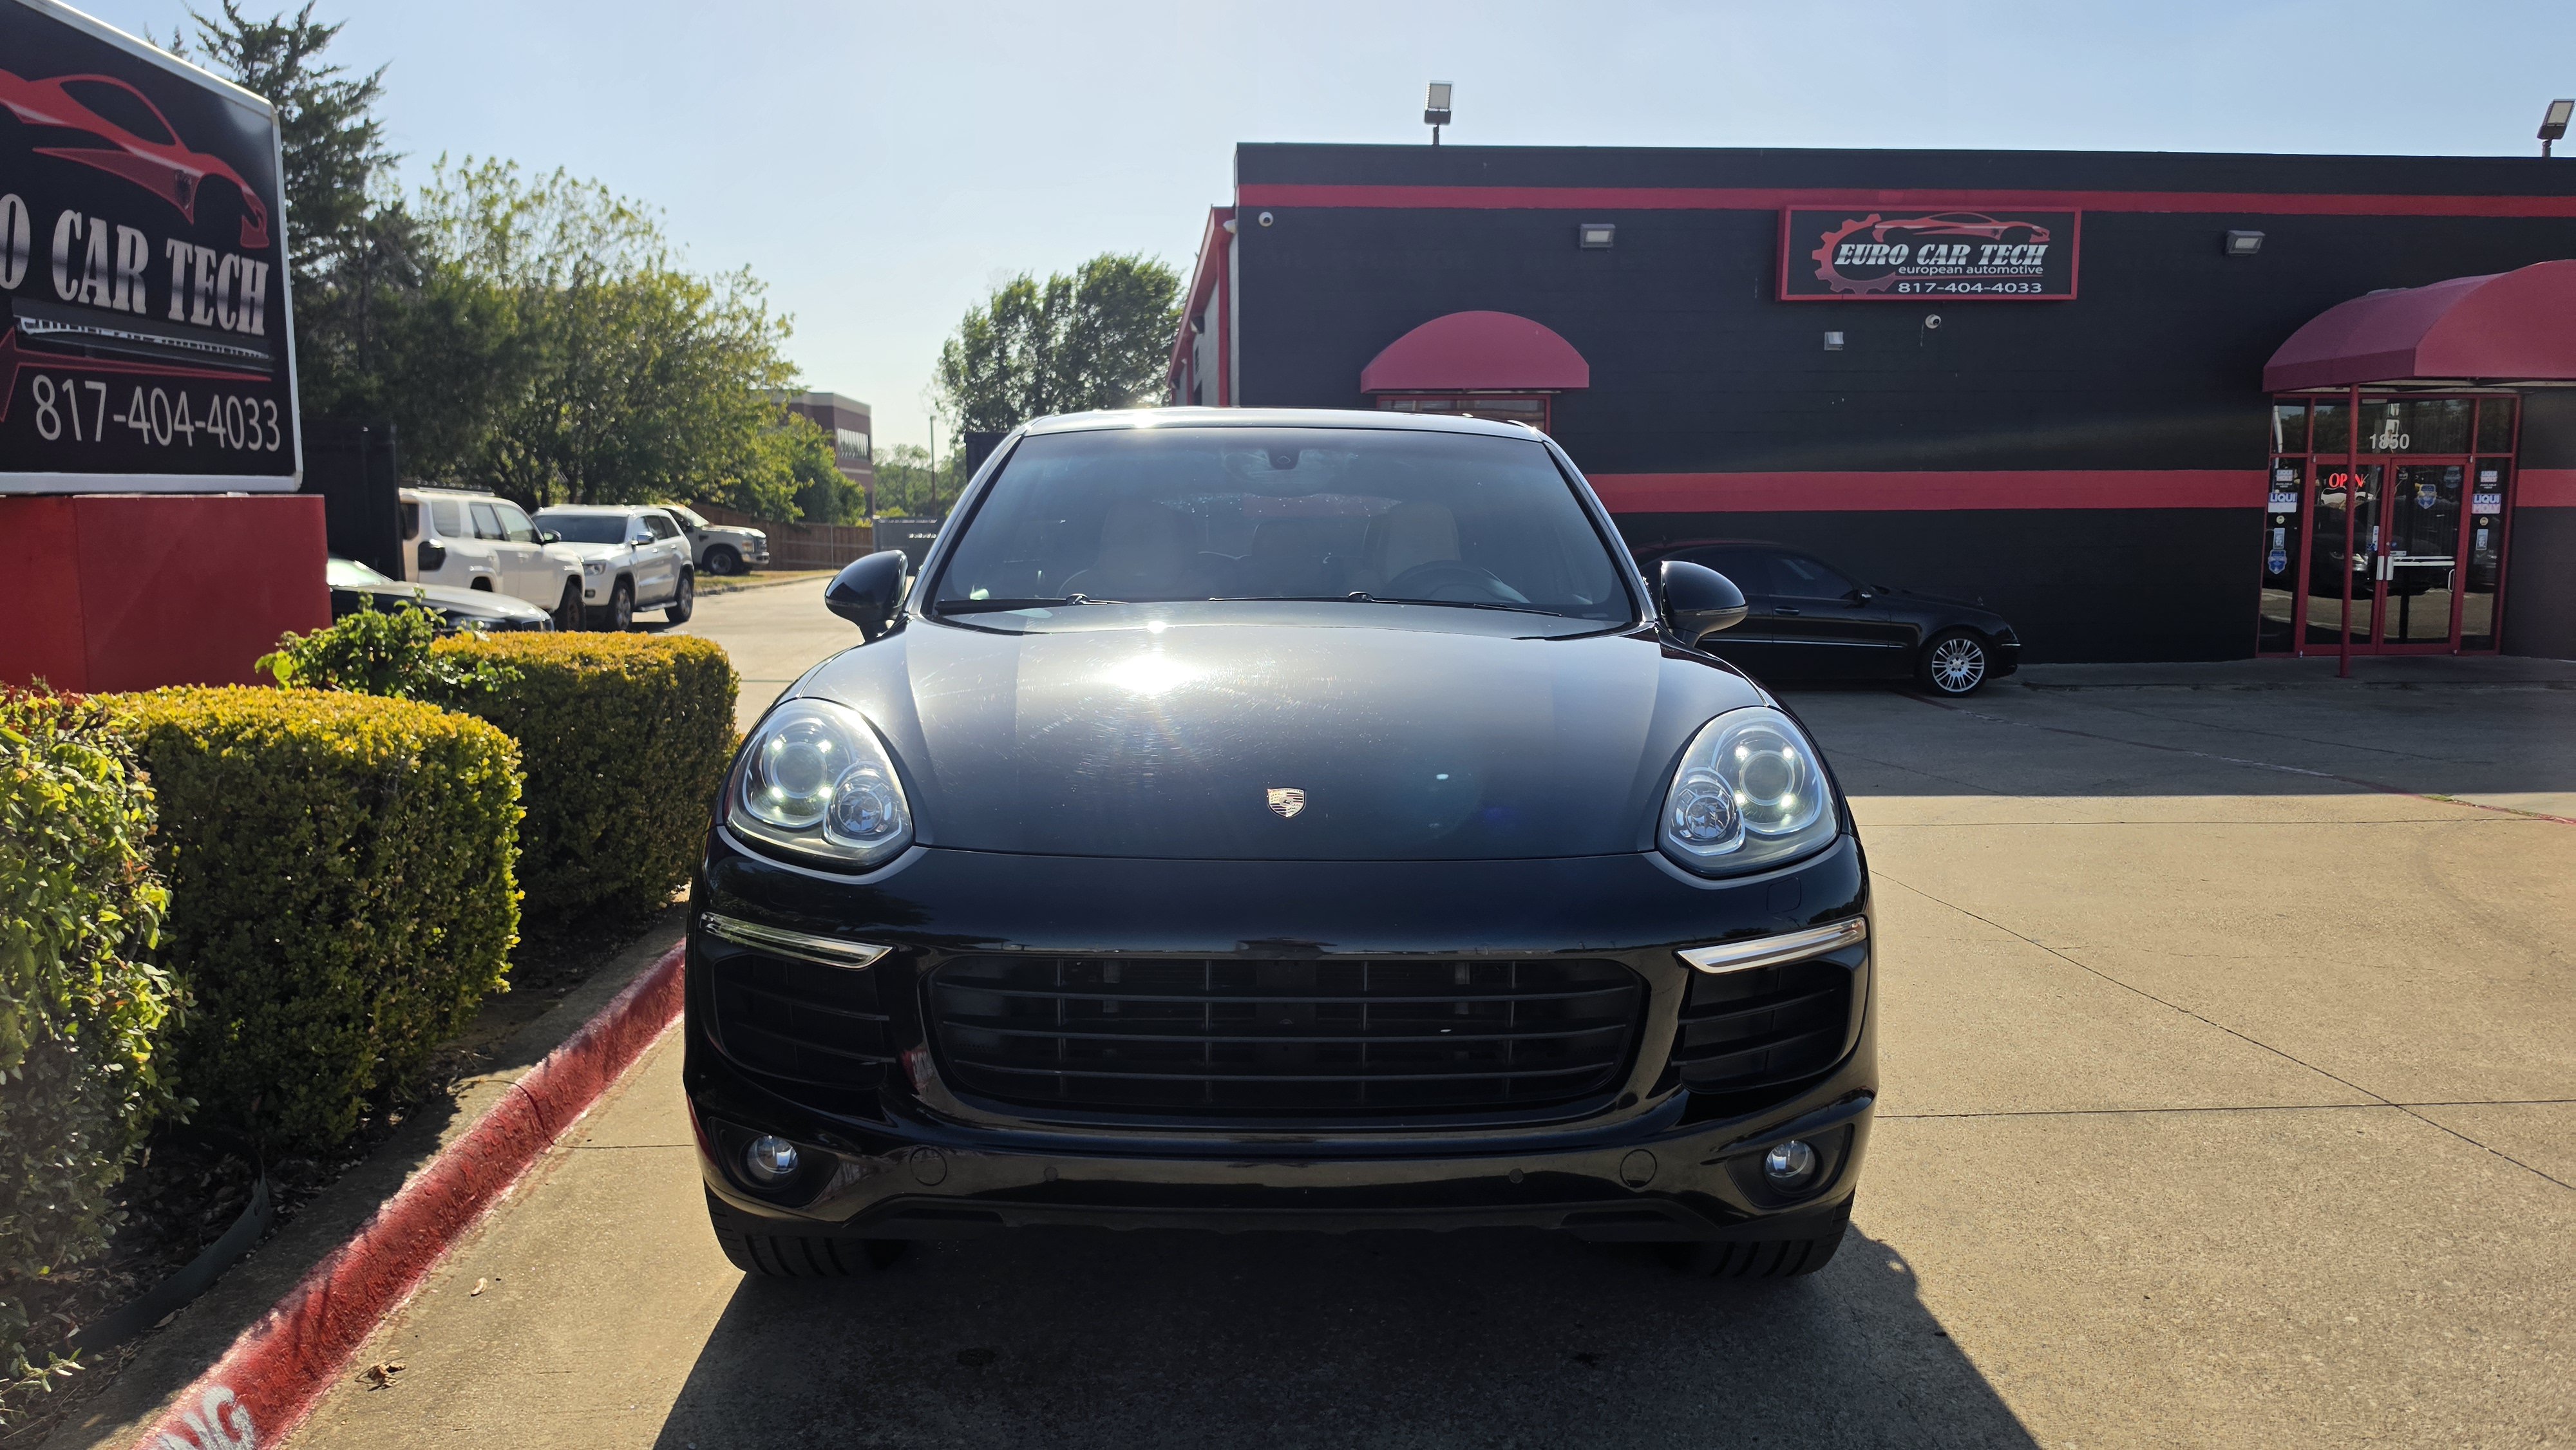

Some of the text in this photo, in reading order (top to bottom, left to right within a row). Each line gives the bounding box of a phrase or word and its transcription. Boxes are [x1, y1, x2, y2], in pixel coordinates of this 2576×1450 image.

[1834, 243, 2049, 266] EURO CAR TECH
[52, 209, 149, 315] CAR
[166, 238, 269, 335] TECH
[1899, 265, 2043, 276] european automotive
[1898, 282, 2042, 294] 817-404-4033
[33, 375, 280, 451] 817-404-4033
[2369, 433, 2410, 449] 1850
[2329, 473, 2365, 487] OPN
[2270, 493, 2296, 502] LIQUI
[2474, 494, 2499, 503] LIQUI
